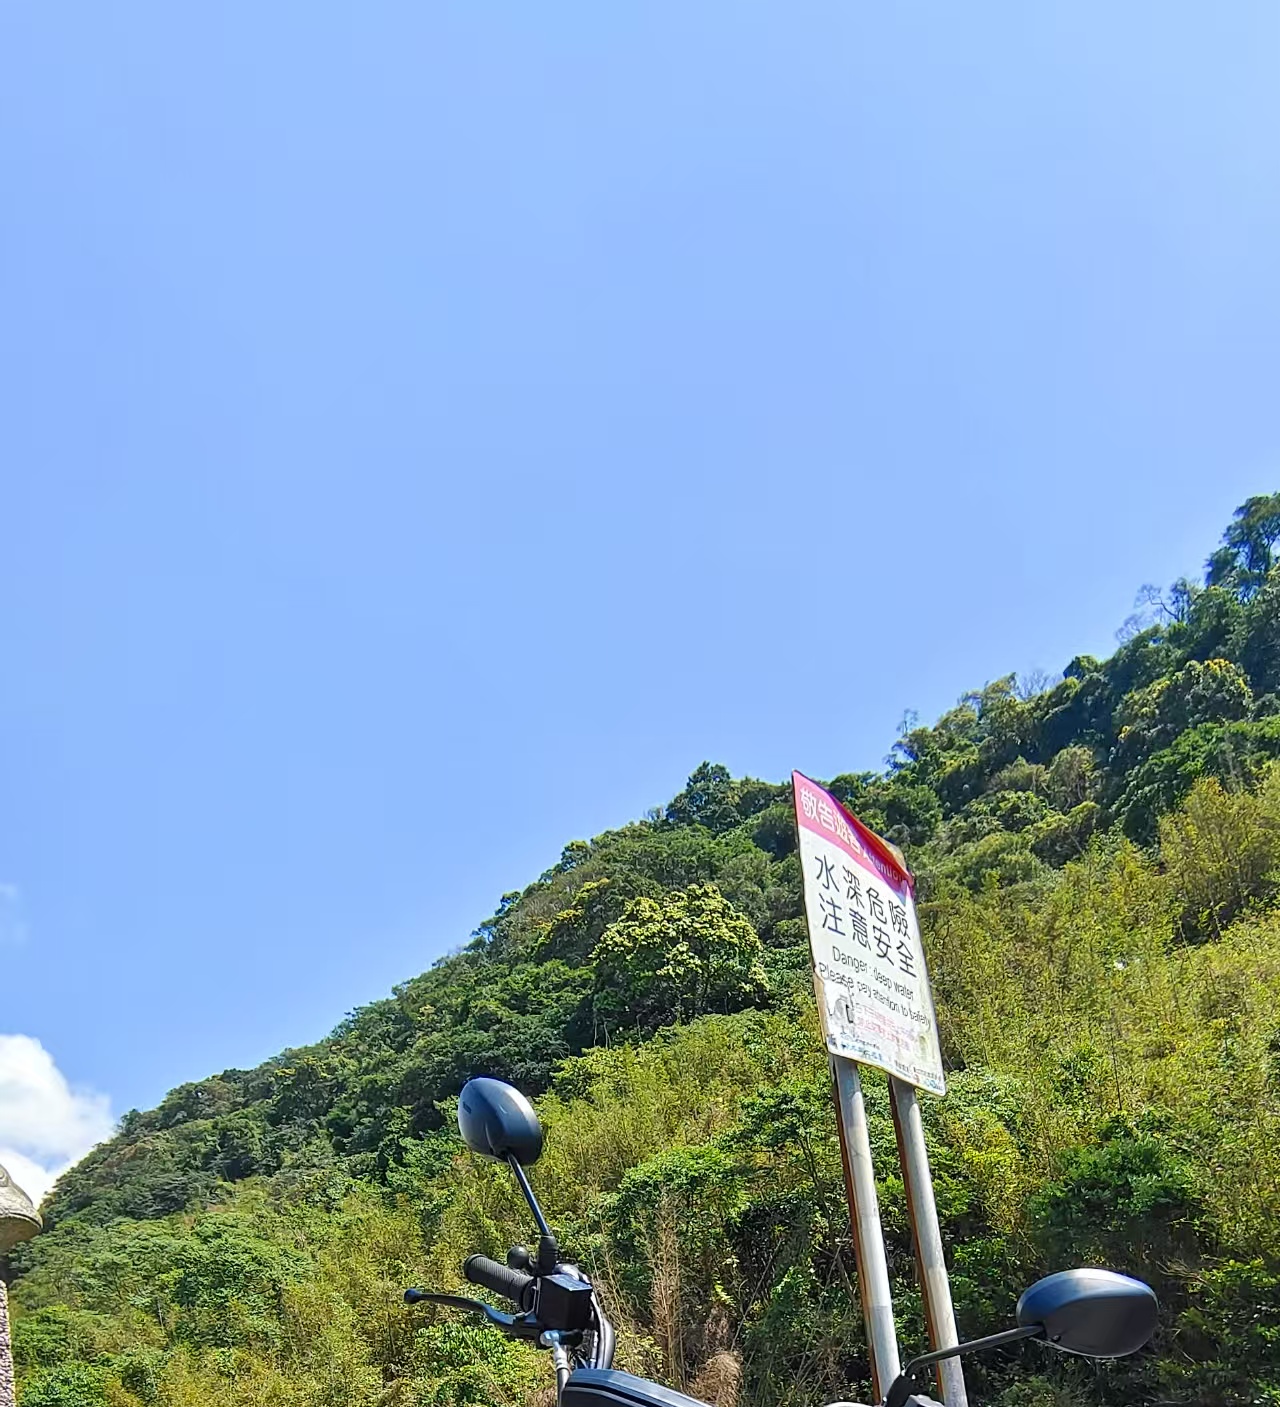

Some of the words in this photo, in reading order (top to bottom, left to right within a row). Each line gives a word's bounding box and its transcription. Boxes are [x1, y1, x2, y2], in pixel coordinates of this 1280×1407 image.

[814, 854, 911, 940] 水深危險
[818, 893, 917, 978] 注意安全
[818, 962, 854, 988] Please
[873, 967, 892, 990] deep
[893, 981, 914, 1000] water
